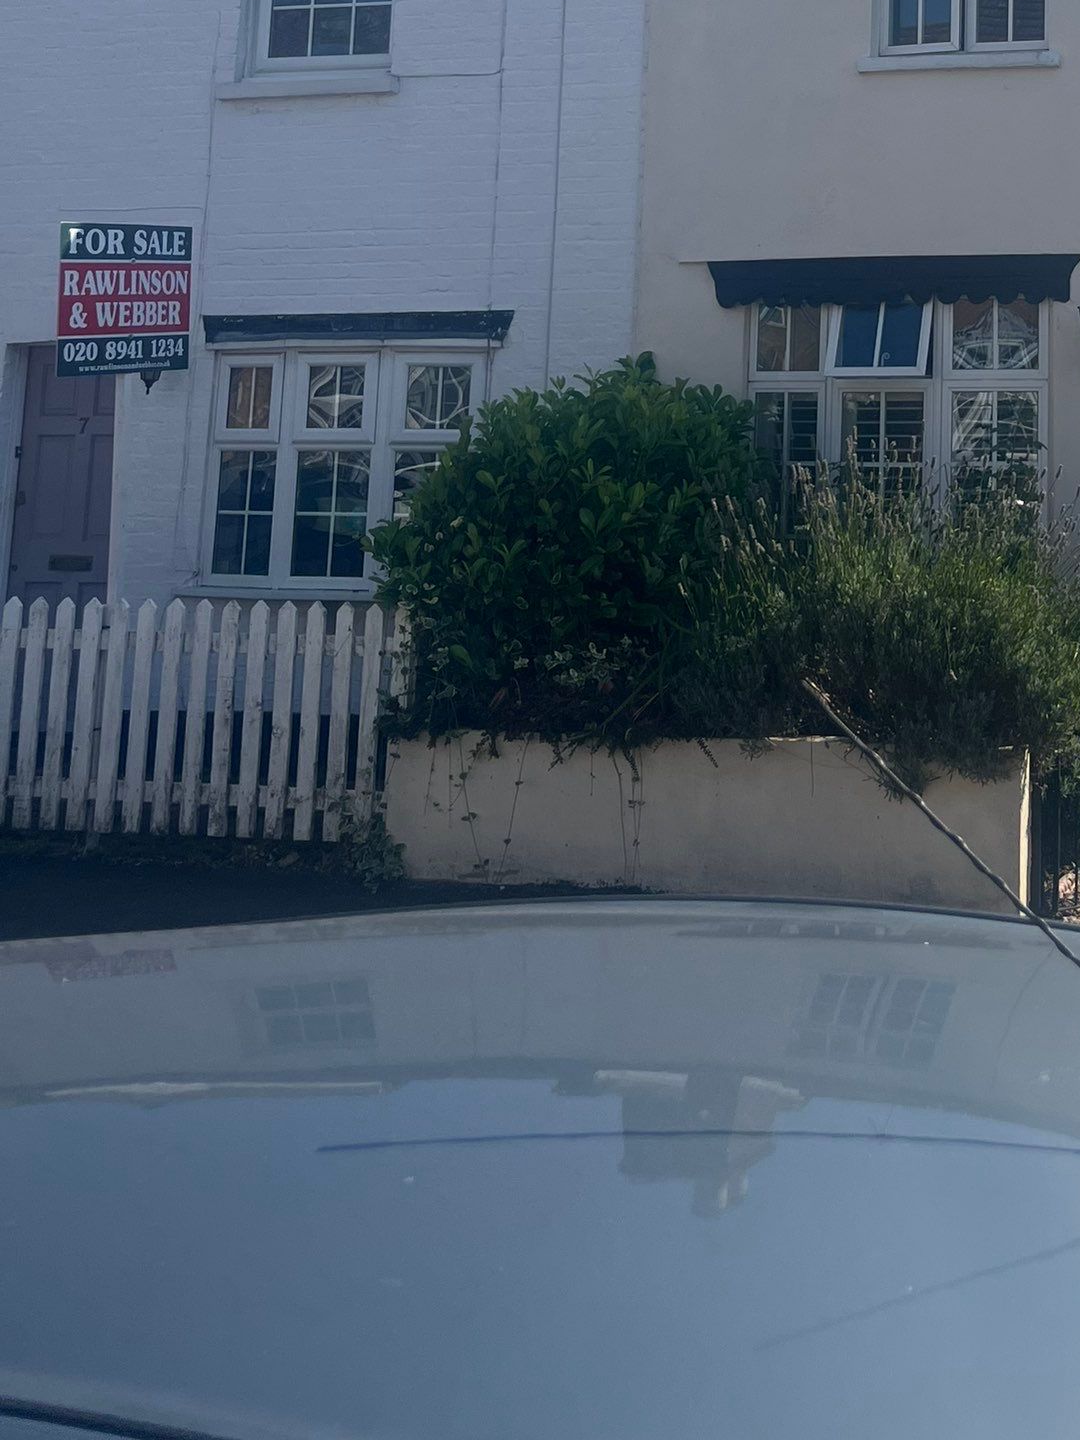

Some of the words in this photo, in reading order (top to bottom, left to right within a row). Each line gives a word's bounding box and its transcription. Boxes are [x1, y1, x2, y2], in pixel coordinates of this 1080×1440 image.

[69, 228, 125, 255] FOR
[133, 229, 186, 256] SALE
[63, 270, 189, 296] RAWLINSON
[69, 302, 88, 329] &
[95, 301, 181, 327] WEBBER
[63, 342, 98, 362] 020
[105, 340, 144, 361] 8941
[150, 338, 184, 358] 1234
[79, 417, 90, 434] 7
